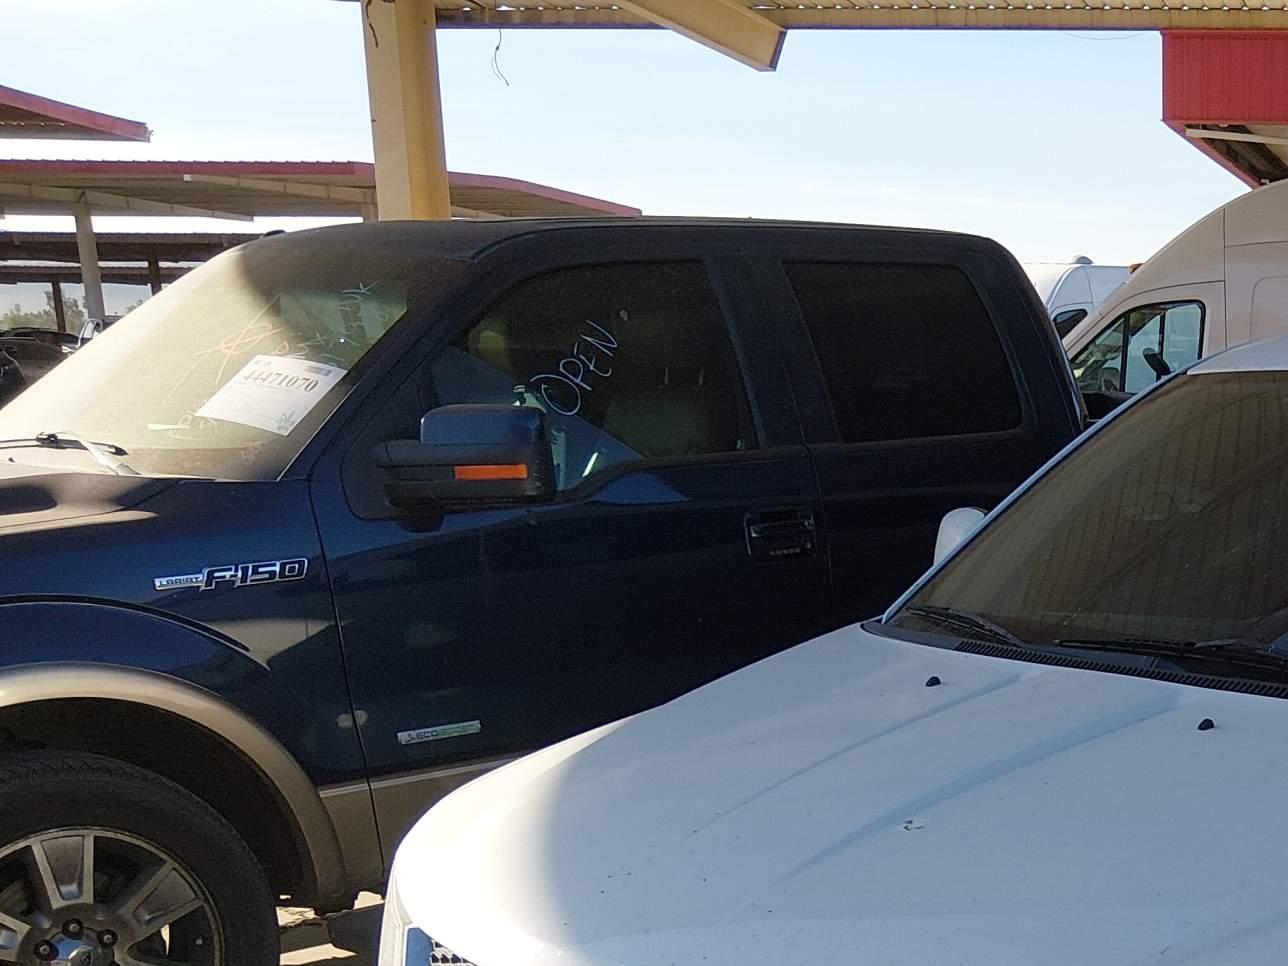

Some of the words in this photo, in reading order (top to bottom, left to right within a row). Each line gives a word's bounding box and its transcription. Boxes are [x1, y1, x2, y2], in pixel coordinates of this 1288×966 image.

[243, 367, 320, 393] 44471070
[530, 319, 618, 415] OPEN
[200, 558, 309, 592] F-150
